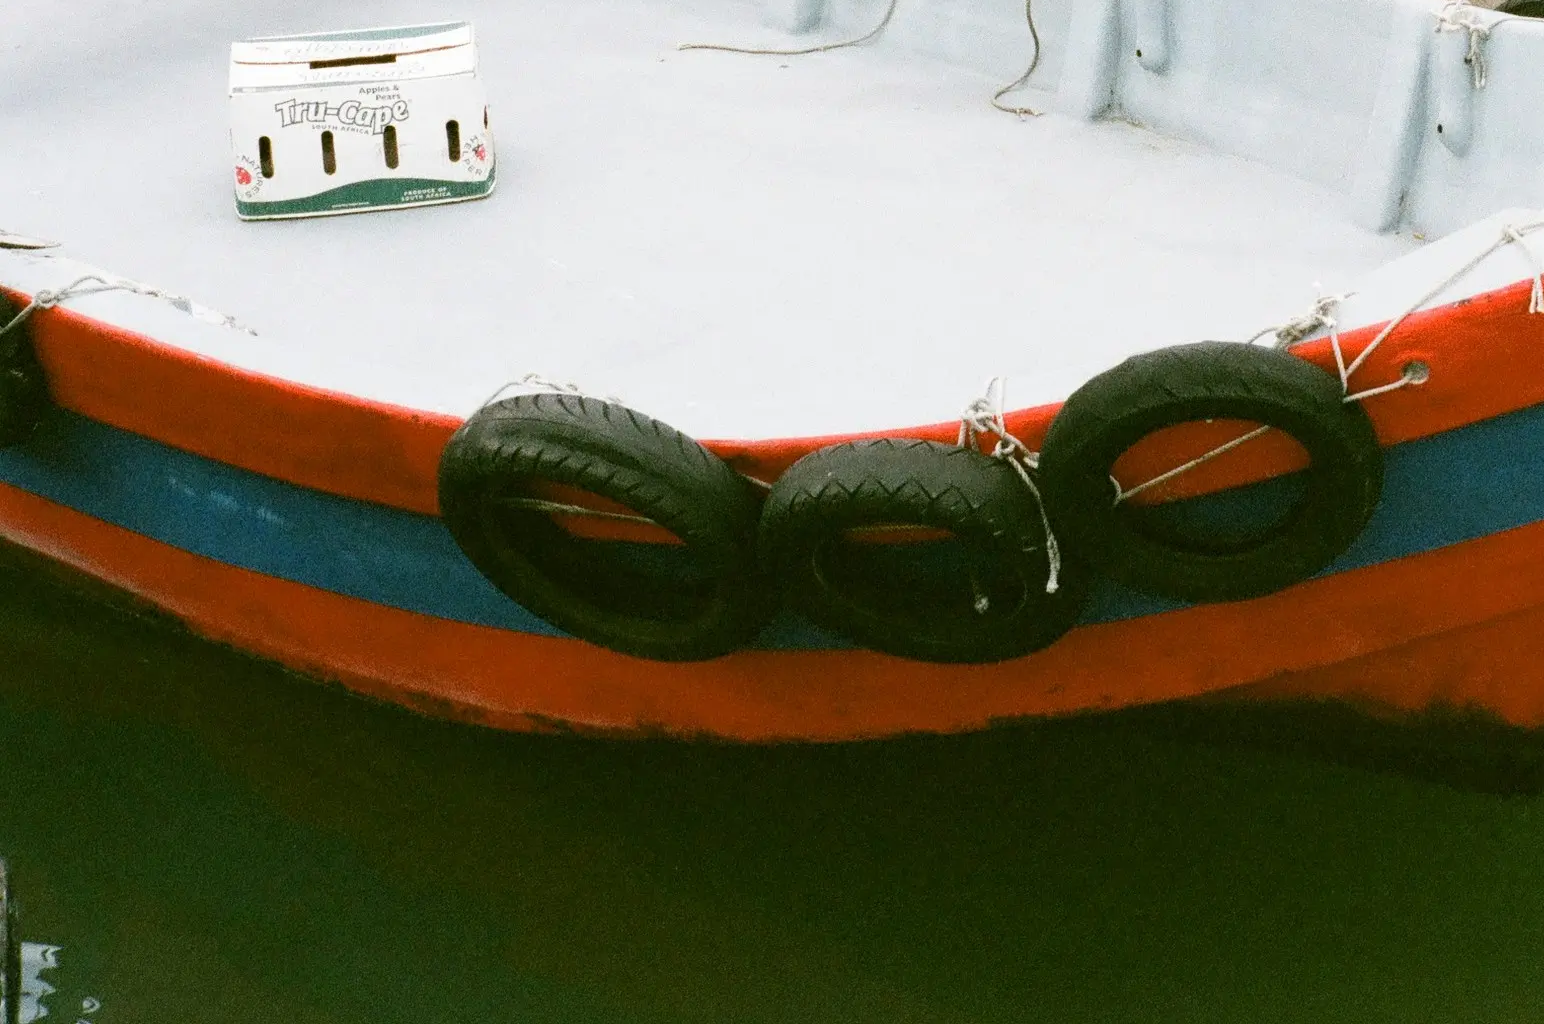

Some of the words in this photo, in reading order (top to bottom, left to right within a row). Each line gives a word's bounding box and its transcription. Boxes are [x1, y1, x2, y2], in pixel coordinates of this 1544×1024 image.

[359, 85, 390, 95] Apples
[375, 93, 401, 101] Pears
[275, 98, 409, 136] Tru-Cape
[311, 123, 338, 131] SOUTH
[340, 125, 370, 135] AFRICA
